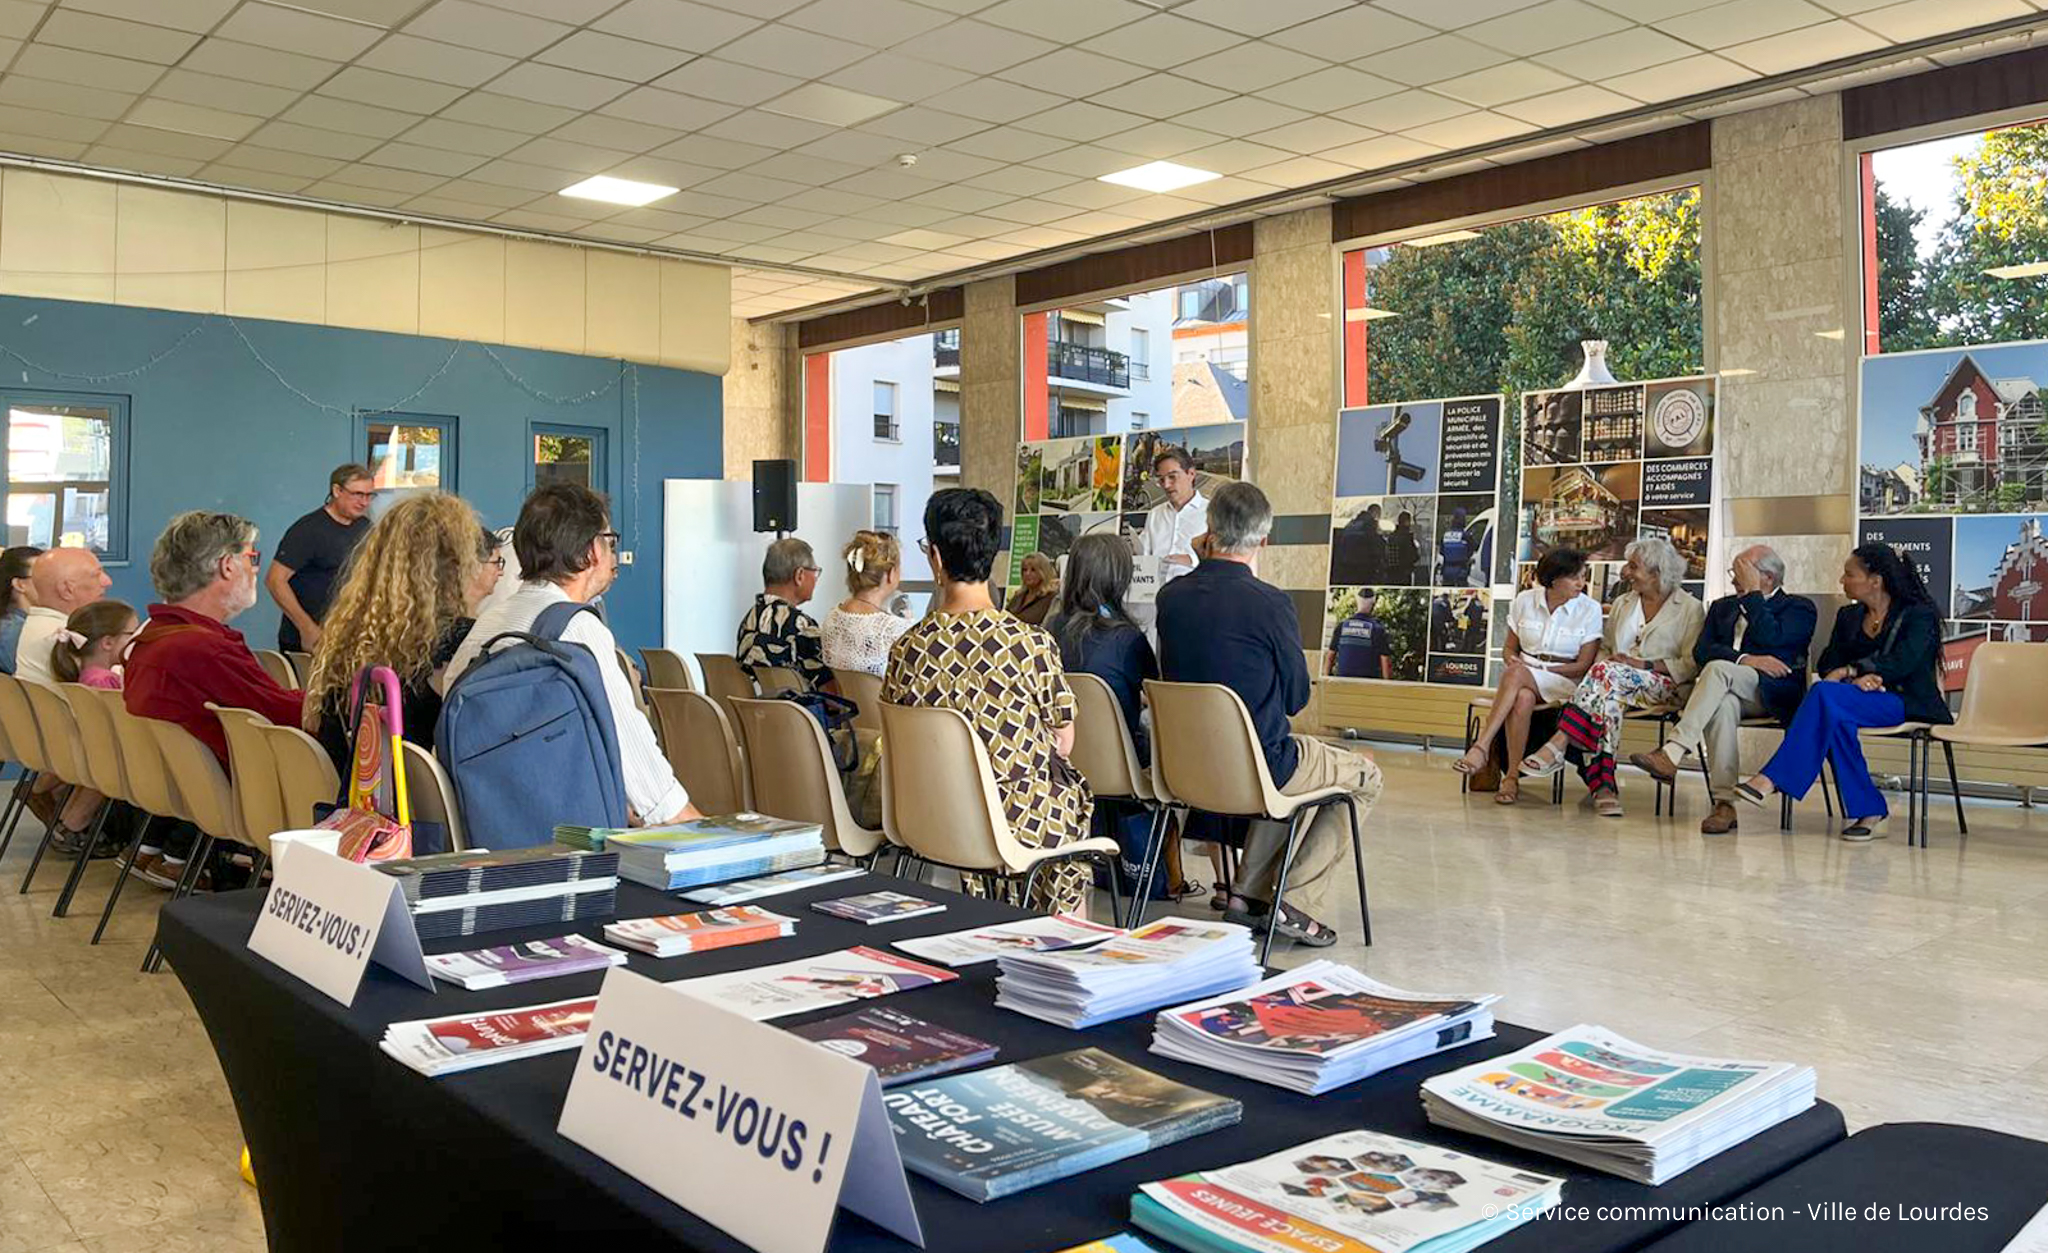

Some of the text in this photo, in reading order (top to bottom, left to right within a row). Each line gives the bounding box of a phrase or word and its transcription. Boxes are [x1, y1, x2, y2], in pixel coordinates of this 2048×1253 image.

[1457, 406, 1481, 414] POLICE
[1447, 414, 1487, 424] MUNICIPALE
[1445, 443, 1471, 451] sécurité
[1444, 451, 1479, 460] prévention
[1453, 461, 1472, 470] place
[1472, 460, 1489, 469] pour
[1645, 462, 1709, 473] DES COMMERCES
[1443, 469, 1481, 478] renforcer la
[1645, 472, 1703, 483] ACCOMPAGNÉS
[1443, 479, 1469, 487] sécurité
[1645, 482, 1676, 492] ET AIDÉS
[1644, 492, 1695, 501] à votre service
[1866, 532, 1885, 541] DES
[1445, 662, 1478, 672] LOURDES
[269, 887, 358, 956] SERVEZ-VOUS
[593, 1030, 808, 1171] SERVEZ-VOUS
[985, 1065, 1110, 1132] PYRÉNÉEN
[911, 1088, 983, 1124] FORT
[1450, 1087, 1647, 1135] PROGRAMME
[881, 1092, 995, 1154] CHÂTEAU
[1190, 1189, 1266, 1222] JEUNES
[1259, 1218, 1345, 1252] ESPACE
